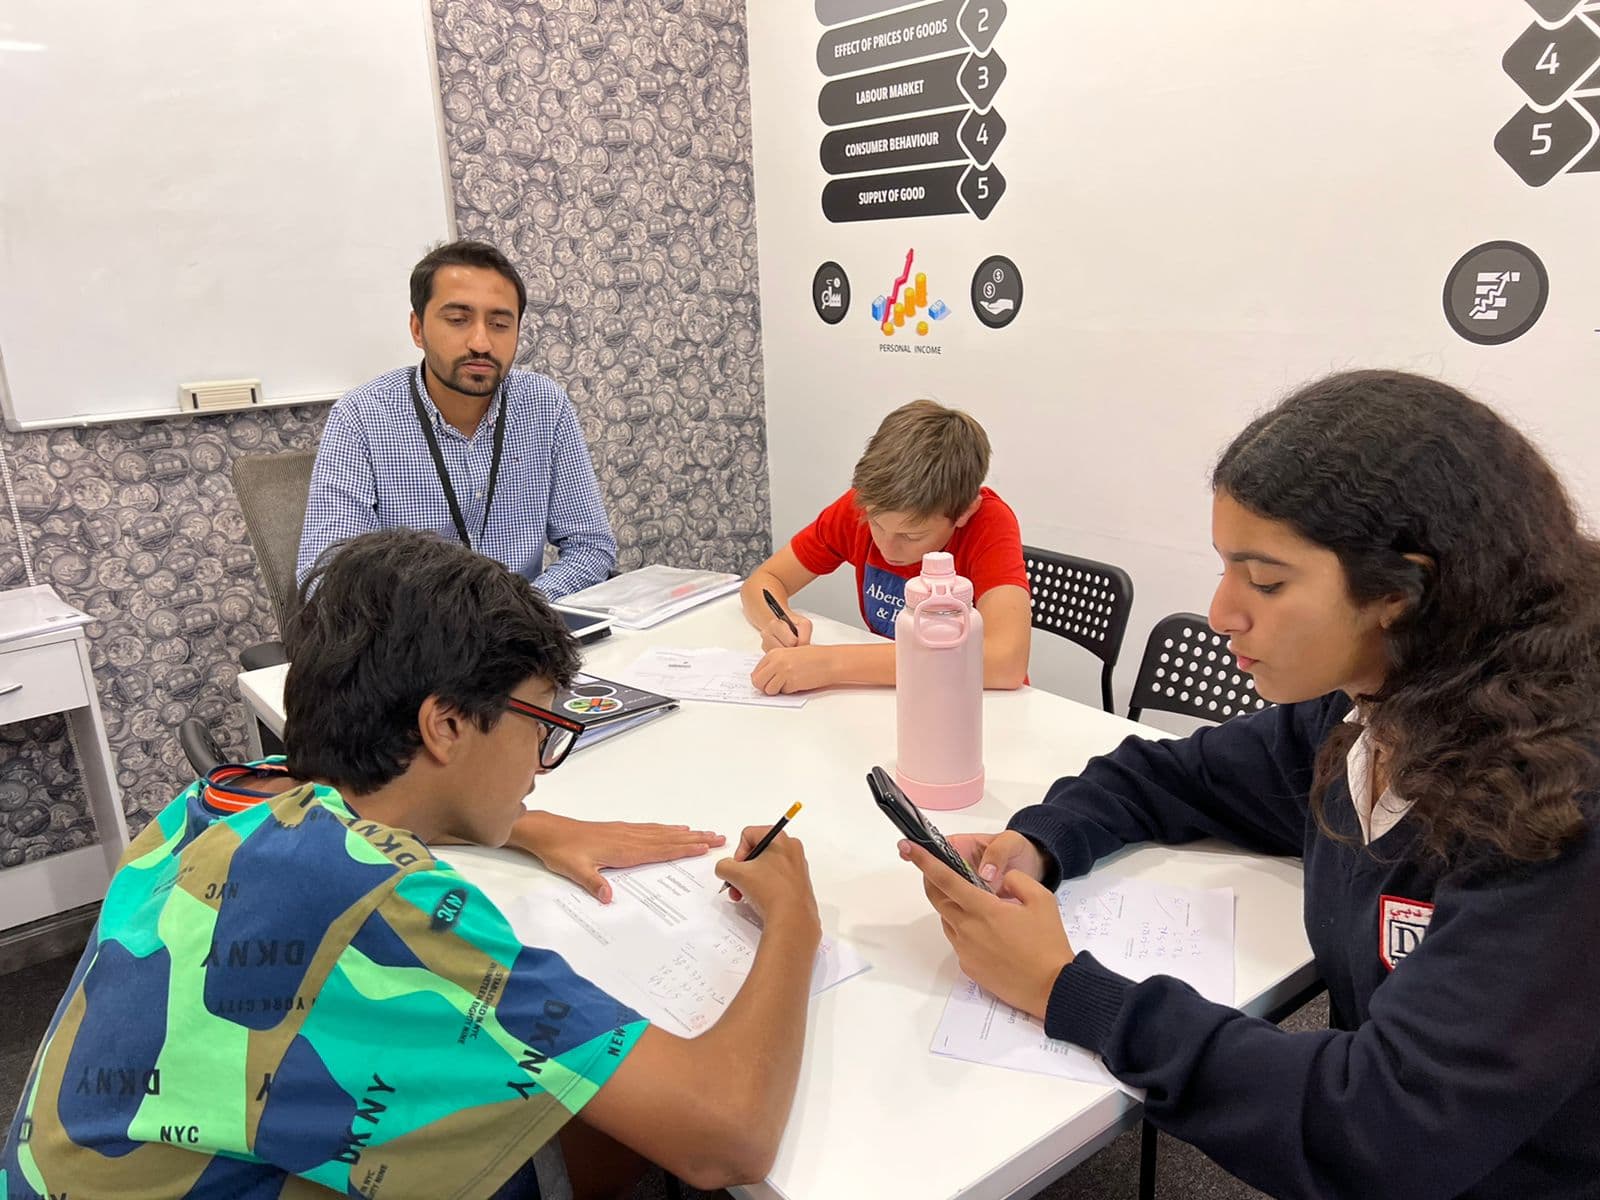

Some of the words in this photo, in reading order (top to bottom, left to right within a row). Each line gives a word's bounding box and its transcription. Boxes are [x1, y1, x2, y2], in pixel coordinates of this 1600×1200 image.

[977, 8, 989, 32] 2
[834, 40, 861, 58] EFFECT
[861, 36, 872, 51] OF
[873, 30, 902, 49] PRICES
[903, 27, 915, 42] OF
[916, 18, 948, 38] GOODS
[1535, 42, 1560, 75] 4
[977, 66, 989, 90] 3
[856, 86, 888, 104] LABOUR
[889, 79, 925, 98] MARKET
[845, 139, 889, 157] CONSUMER
[889, 131, 939, 150] BEHAVIOUR
[976, 122, 989, 146] 4
[1529, 122, 1553, 156] 5
[858, 189, 888, 205] SUPPLY
[888, 188, 899, 202] OF
[900, 186, 926, 201] GOOD
[977, 176, 989, 200] 5
[879, 343, 912, 353] PERSONAL
[914, 345, 942, 355] INCOME
[866, 583, 905, 608] Aberc
[876, 607, 889, 620] &
[437, 893, 464, 923] NYC
[201, 940, 306, 969] DKNY
[507, 999, 573, 1101] DKNY
[76, 1066, 161, 1096] DKNY
[338, 1072, 396, 1166] DKNY
[160, 1125, 199, 1144] NYC
